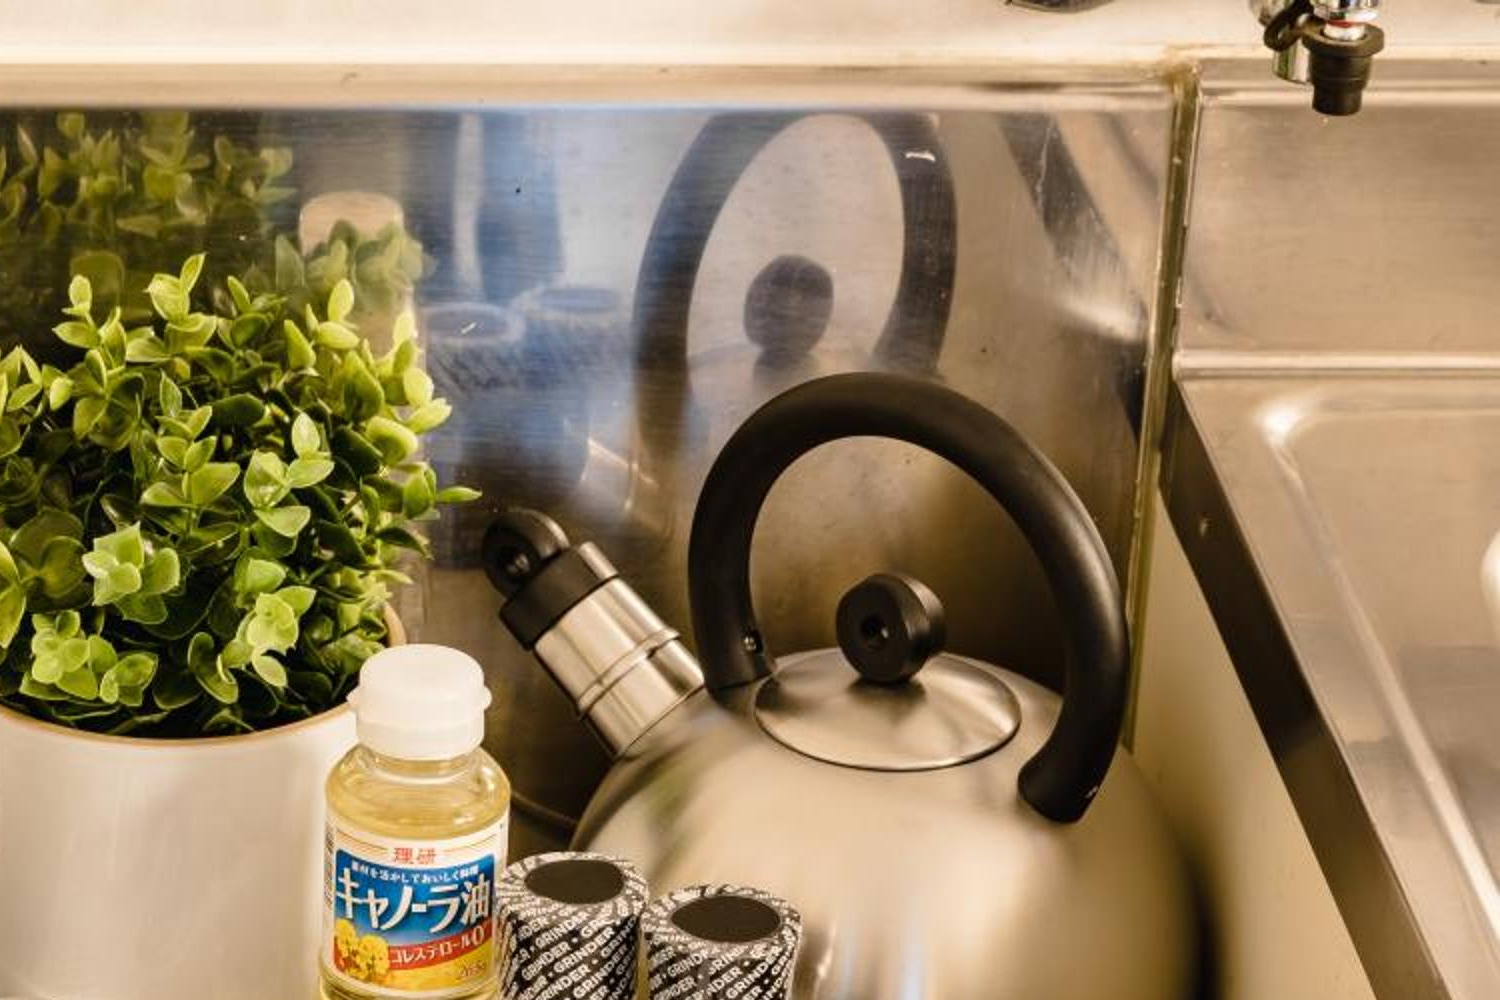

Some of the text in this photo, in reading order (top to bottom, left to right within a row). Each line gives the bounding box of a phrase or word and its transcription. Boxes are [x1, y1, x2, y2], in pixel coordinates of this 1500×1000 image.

[336, 867, 490, 933] キャノーラ油
[553, 927, 615, 973] GRINDER
